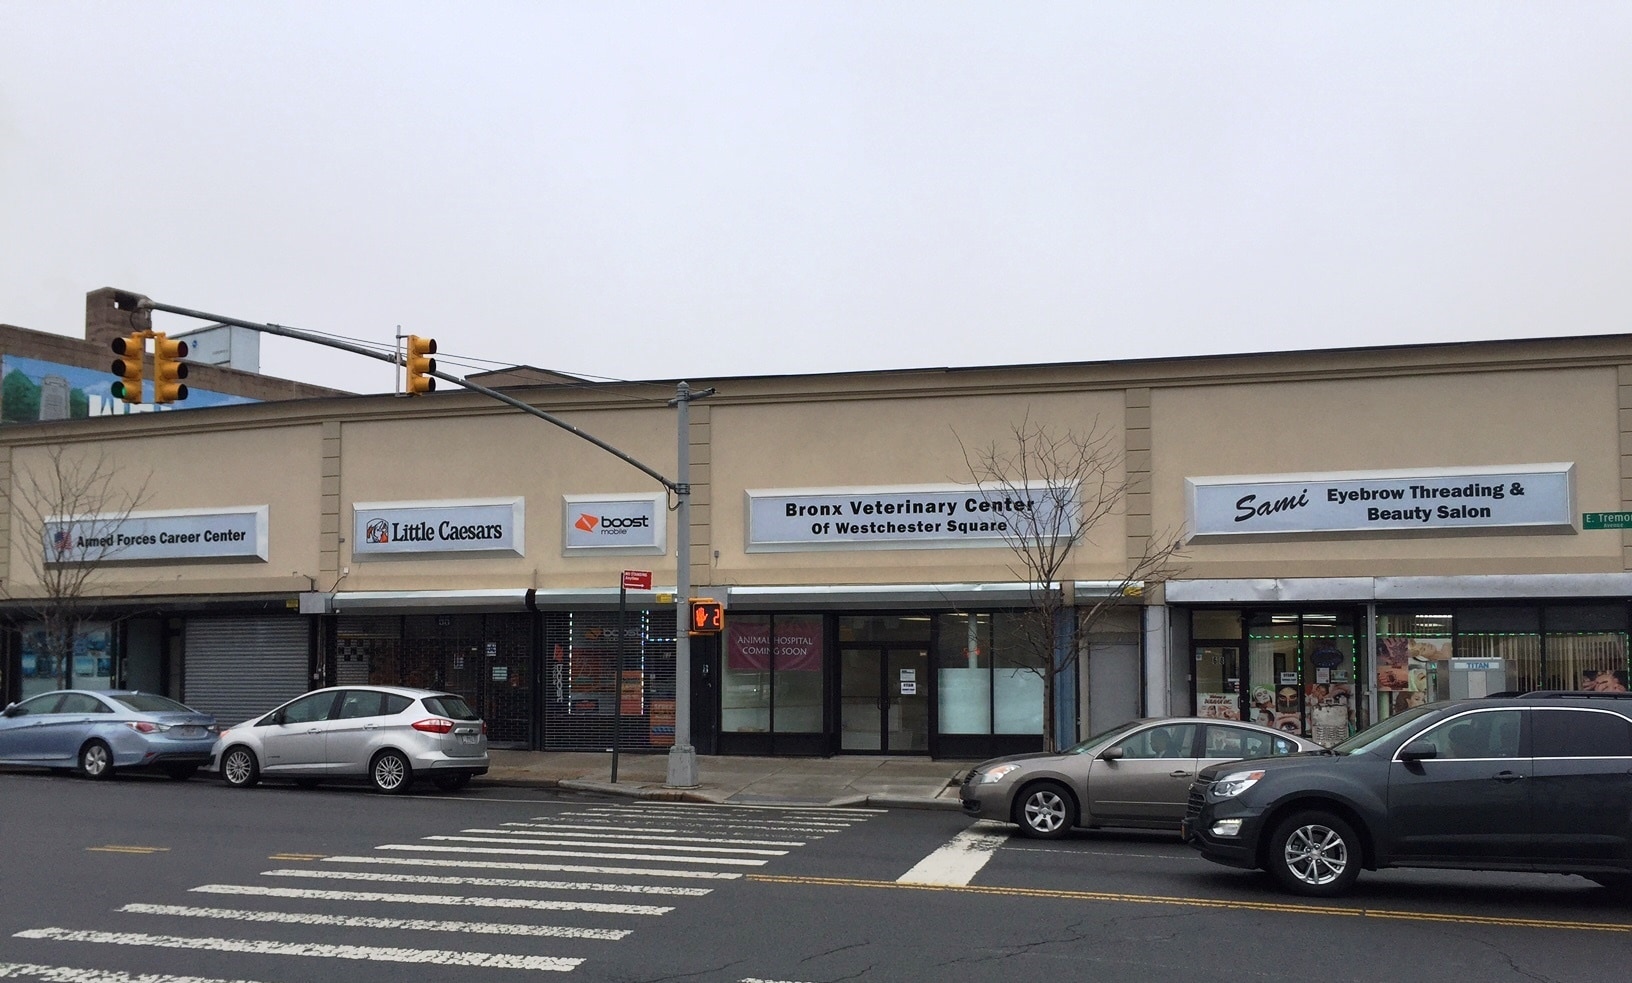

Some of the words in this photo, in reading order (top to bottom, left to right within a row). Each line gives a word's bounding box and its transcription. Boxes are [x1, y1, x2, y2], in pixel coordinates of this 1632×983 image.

[1327, 486, 1405, 504] Eyebrow
[1409, 482, 1505, 500] Threading
[1509, 482, 1525, 496] &
[785, 502, 843, 517] Bronx
[850, 499, 958, 516] Veterinary
[964, 497, 1035, 513] Center
[1234, 488, 1309, 522] Sami
[1367, 506, 1433, 522] Beauty
[1436, 505, 1491, 519] Salon
[601, 515, 648, 528] boost
[811, 522, 830, 535] Of
[836, 520, 941, 535] Westchester
[946, 519, 1007, 534] Square
[1586, 514, 1595, 523] E.
[1599, 514, 1632, 523] Tremo
[77, 534, 114, 548] Armed
[117, 533, 156, 546] Forces
[160, 531, 201, 544] Career
[204, 530, 246, 543] Center
[391, 522, 434, 542] Little
[438, 520, 503, 540] Caesars
[713, 609, 720, 626] 2
[737, 636, 770, 644] ANIMAL
[773, 636, 813, 645] HOSPITAL
[742, 646, 780, 655] COMING
[781, 647, 807, 656] SOON
